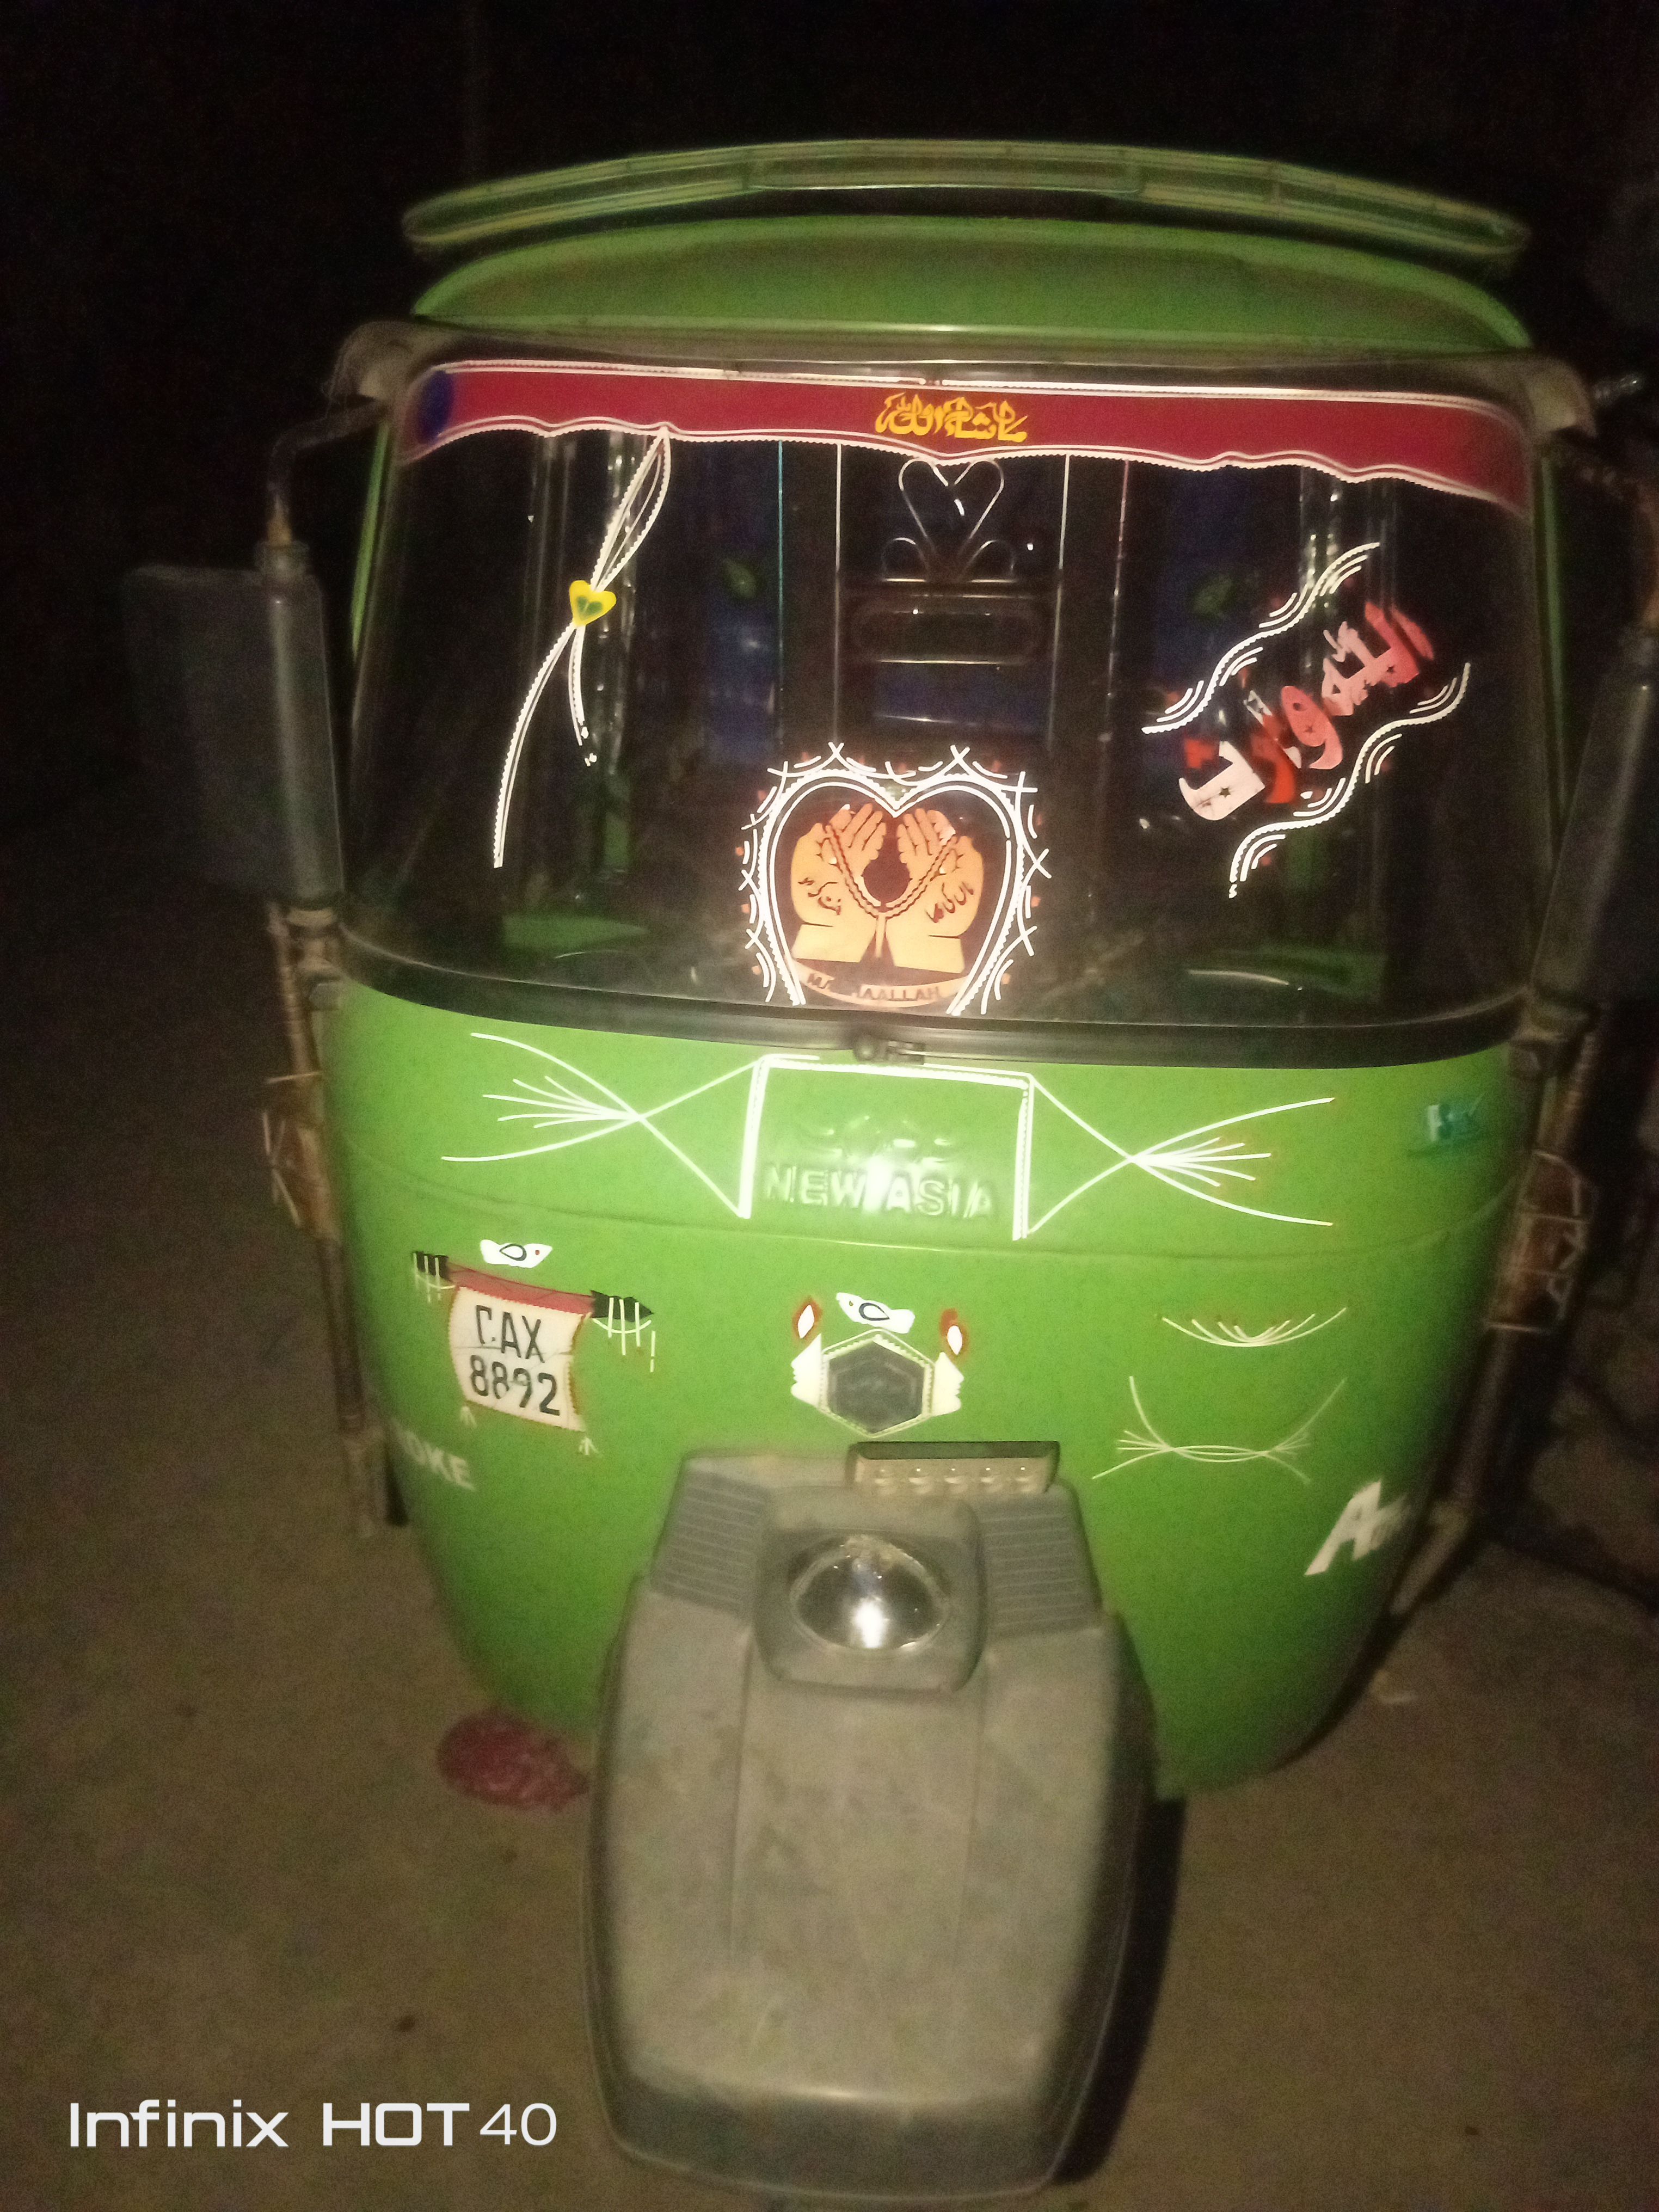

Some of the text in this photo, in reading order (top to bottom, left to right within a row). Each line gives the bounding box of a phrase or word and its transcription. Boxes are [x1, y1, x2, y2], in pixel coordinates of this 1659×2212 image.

[765, 1164, 992, 1219] NEW ASIA
[470, 1355, 560, 1416] 8892
